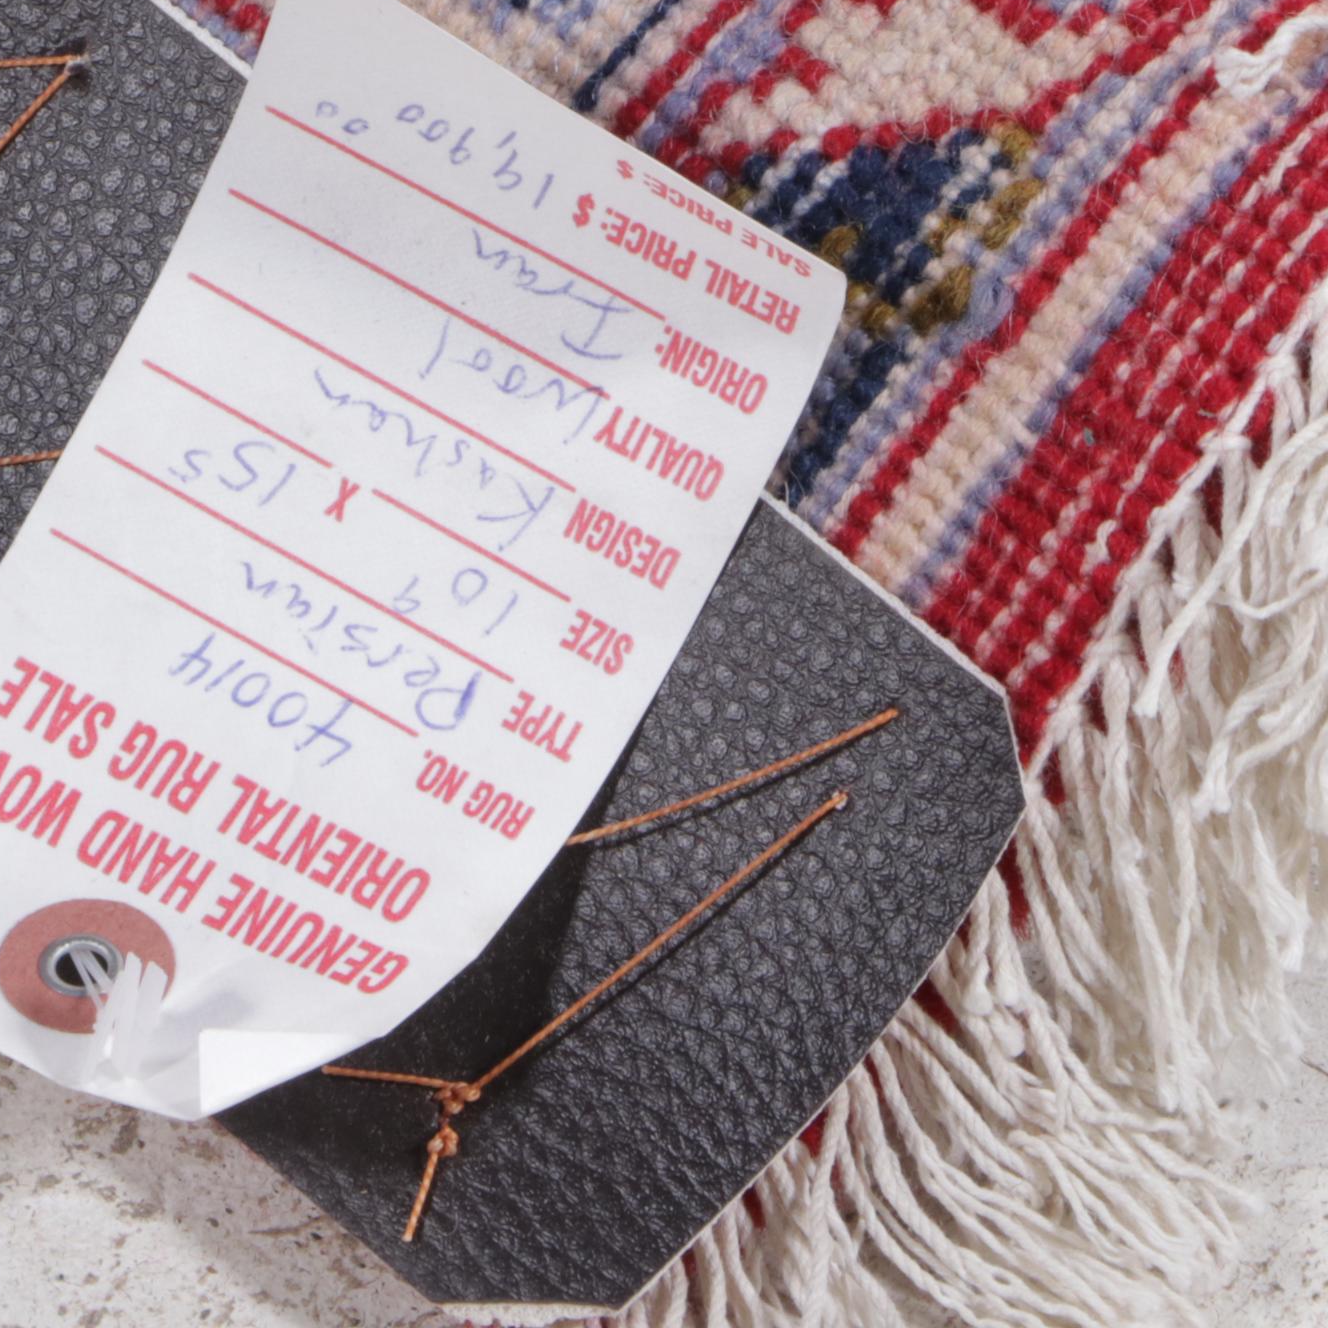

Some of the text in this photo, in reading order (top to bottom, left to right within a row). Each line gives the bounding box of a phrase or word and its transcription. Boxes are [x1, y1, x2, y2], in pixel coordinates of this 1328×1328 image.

[571, 192, 596, 229] $
[599, 206, 698, 281] PRICE:
[642, 172, 733, 236] PRICE:
[740, 227, 812, 279] SALE
[471, 227, 769, 415] ORIGIN: Iran
[704, 258, 802, 335] RETAIL
[417, 316, 726, 503] QUALITY Wool
[313, 367, 682, 591] DESIGN Kashan
[242, 560, 584, 762] TYPE Persian
[559, 607, 634, 676] SIZE
[106, 720, 222, 815] RUG
[170, 632, 535, 840] RUG NO. 40014
[75, 807, 218, 913] HAND
[215, 773, 432, 924] ORIENTAL
[200, 871, 411, 995] GENUINE
